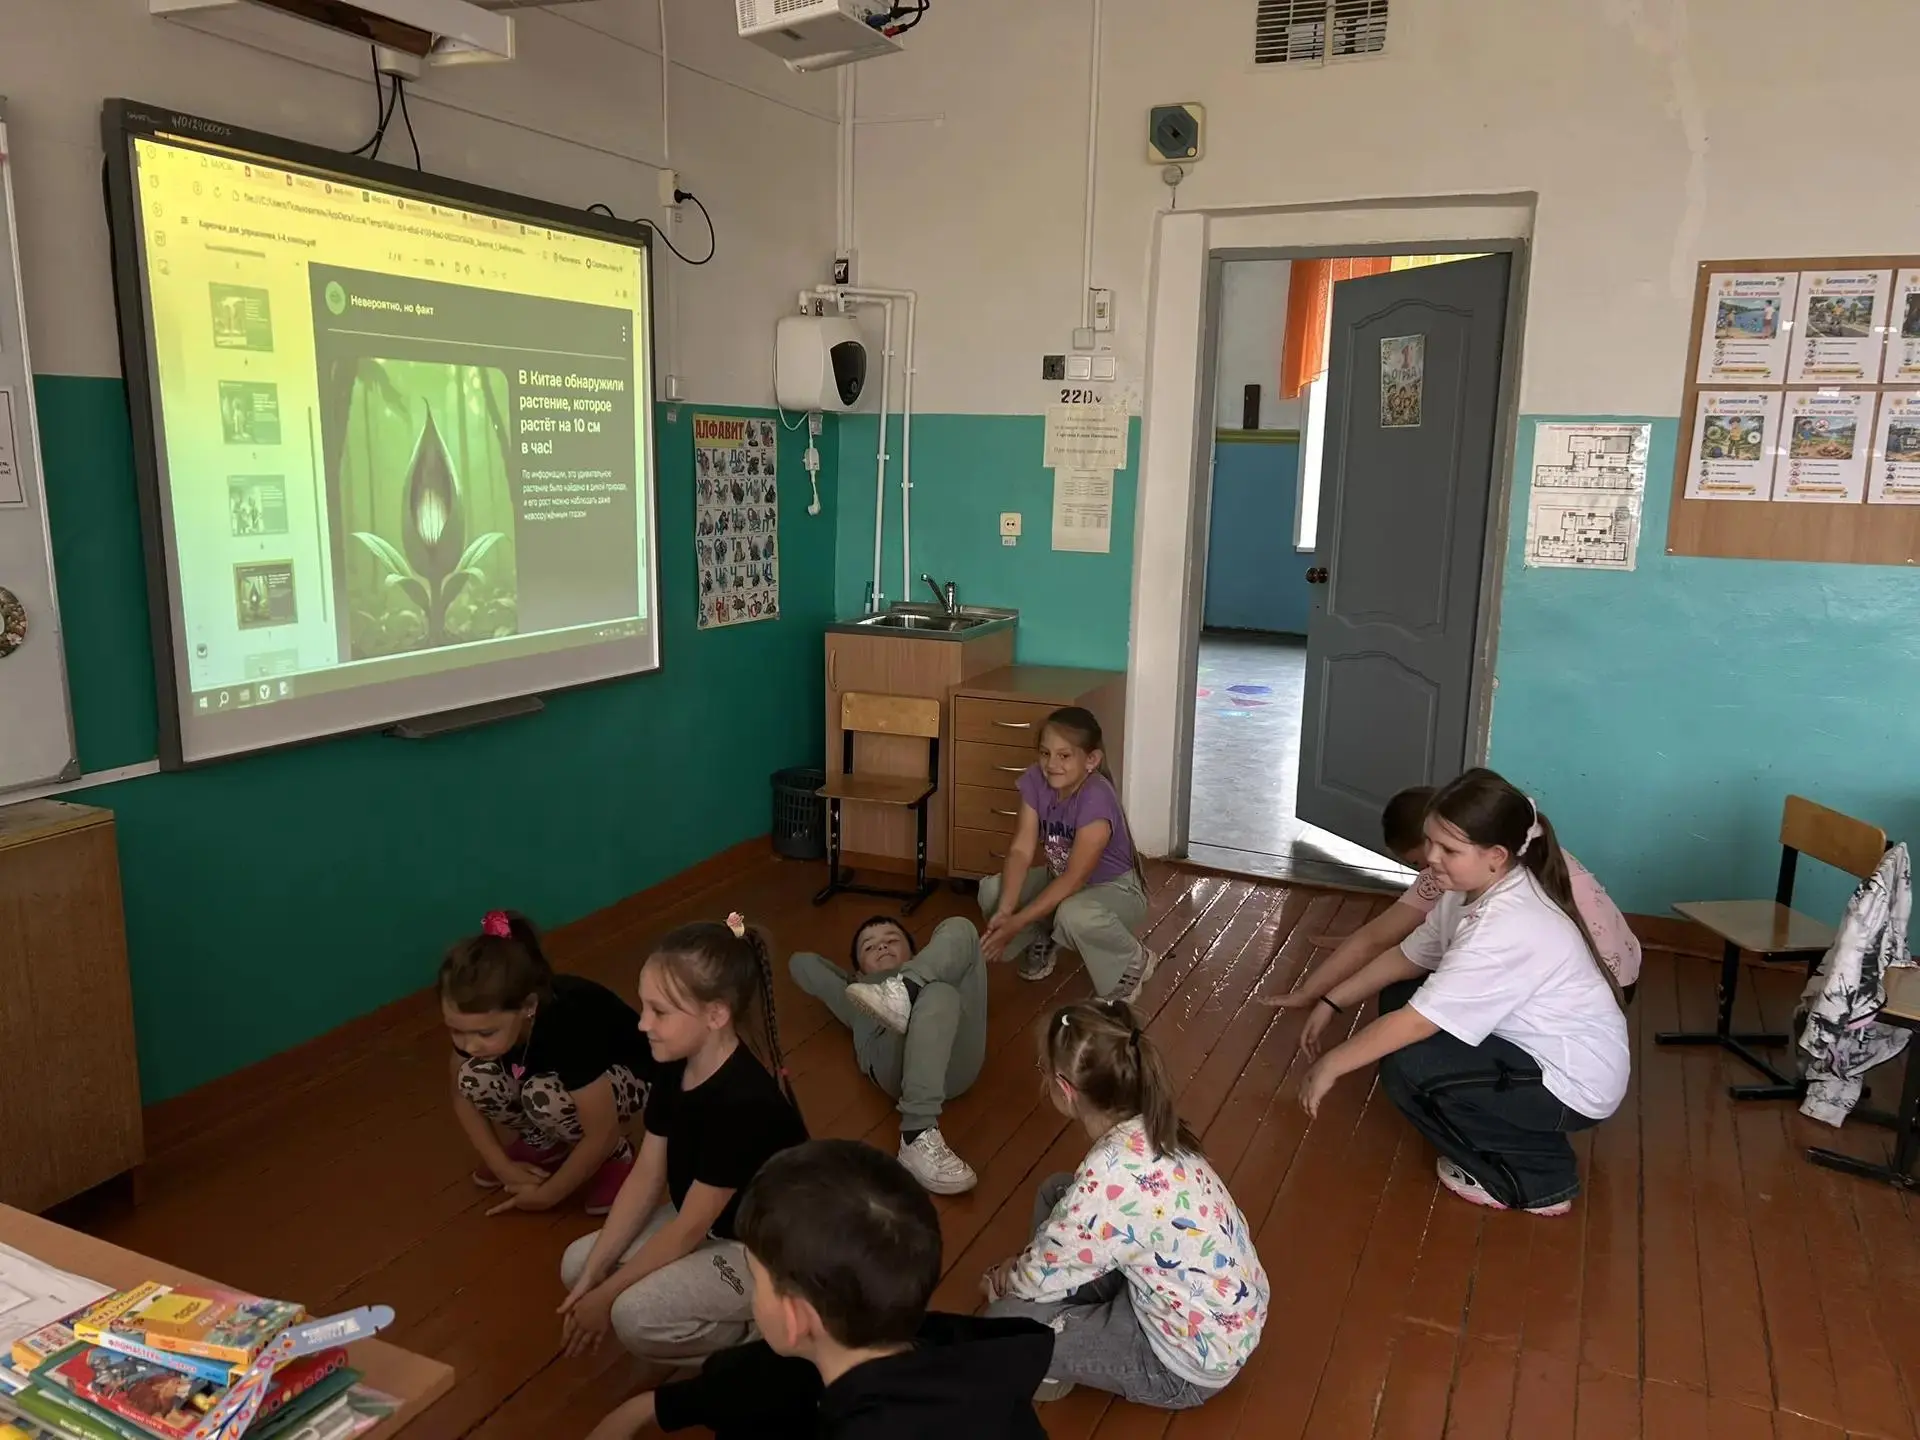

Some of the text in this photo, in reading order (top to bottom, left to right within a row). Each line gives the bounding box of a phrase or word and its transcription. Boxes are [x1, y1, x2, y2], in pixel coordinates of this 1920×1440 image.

[350, 294, 434, 316] Невероятно, но факт
[518, 369, 624, 392] В Китае обнаружили
[519, 396, 612, 414] растение, которое
[520, 418, 601, 434] растёт на 10 см
[695, 420, 745, 440] АЛФАВИТ
[521, 439, 553, 455] в час!
[761, 448, 767, 466] Ё
[745, 478, 753, 496] Й
[761, 479, 768, 493] К
[732, 508, 738, 522] Н
[762, 519, 769, 532] П
[730, 537, 736, 551] Т
[747, 536, 753, 550] У
[763, 590, 769, 604] Я
